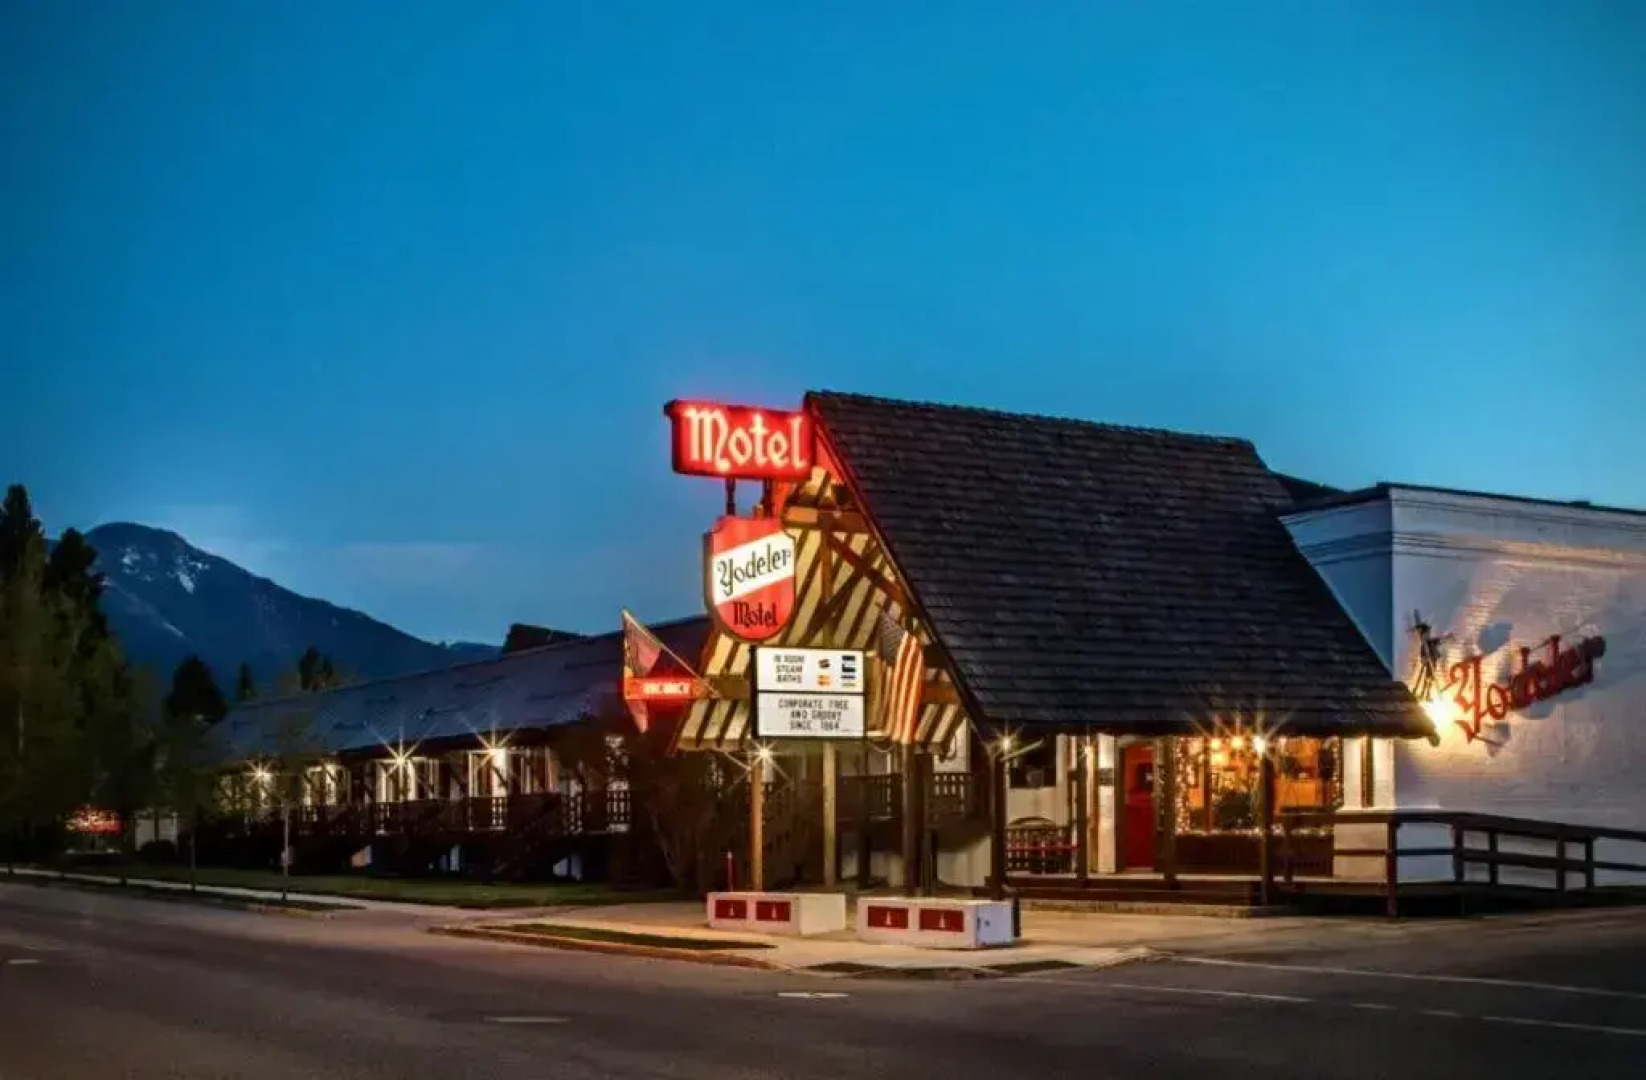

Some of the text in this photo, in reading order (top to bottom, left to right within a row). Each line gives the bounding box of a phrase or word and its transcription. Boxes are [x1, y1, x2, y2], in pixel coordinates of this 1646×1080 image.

[682, 407, 807, 472] Motel
[716, 543, 791, 597] Yodeler
[732, 601, 778, 628] Motel
[776, 664, 802, 672] STEAM
[777, 674, 802, 683] BATHS
[1443, 634, 1606, 743] Yodeler
[778, 699, 823, 709] CORPORATE
[791, 710, 807, 719] AND
